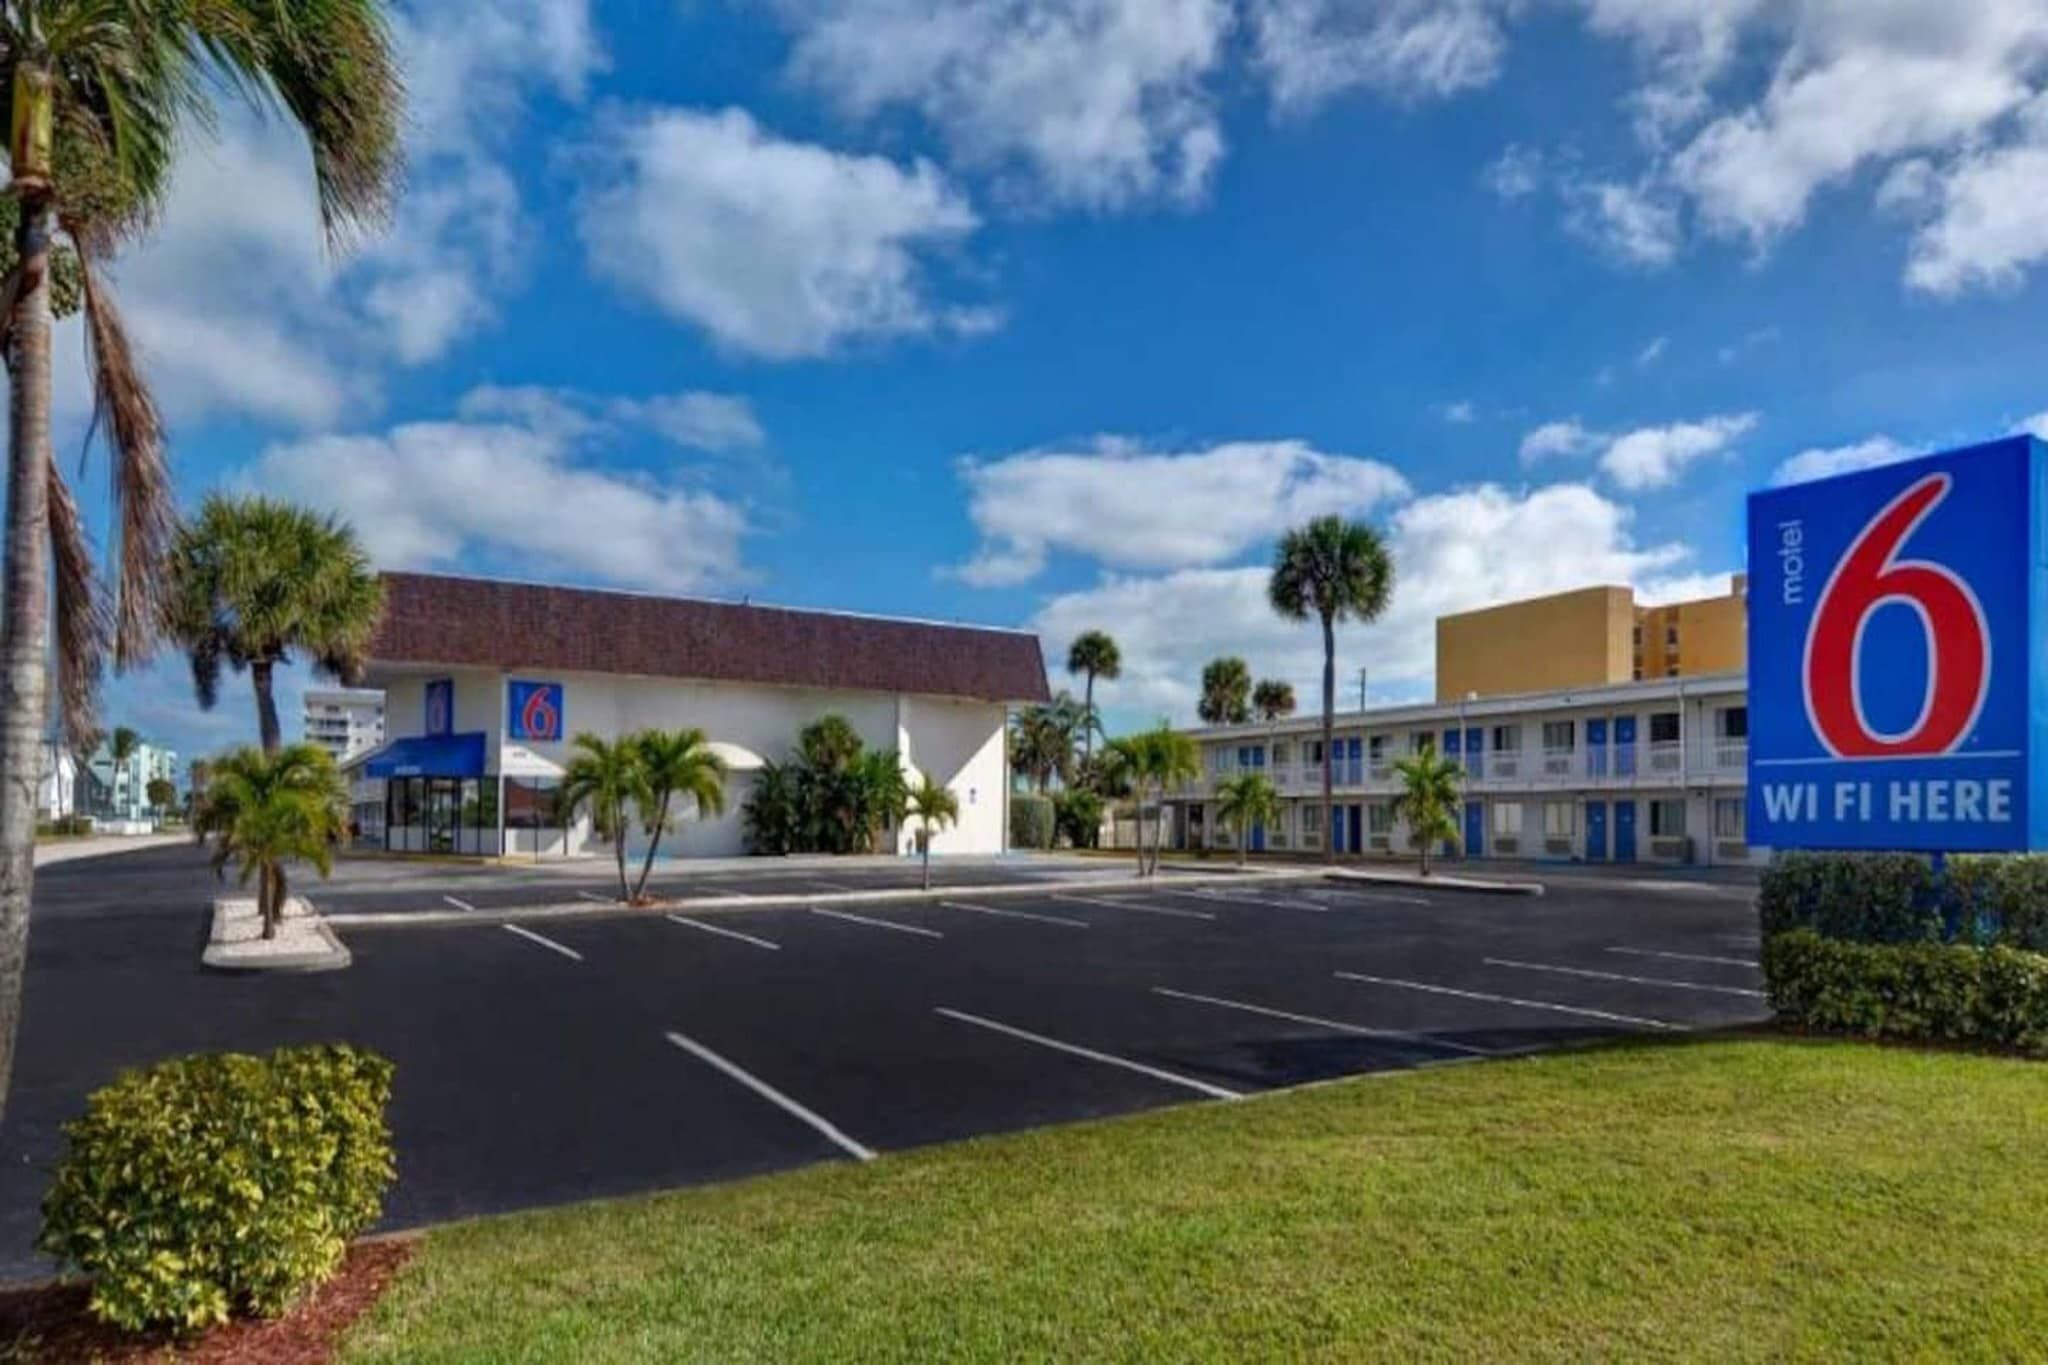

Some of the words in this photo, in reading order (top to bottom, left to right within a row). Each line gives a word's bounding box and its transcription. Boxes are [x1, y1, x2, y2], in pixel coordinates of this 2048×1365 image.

[1777, 520, 1803, 604] motel
[1803, 472, 1992, 759] 6
[523, 687, 556, 740] 6
[1763, 784, 1818, 822] WI
[1834, 782, 1871, 821] FI
[1890, 780, 2011, 821] HERE
